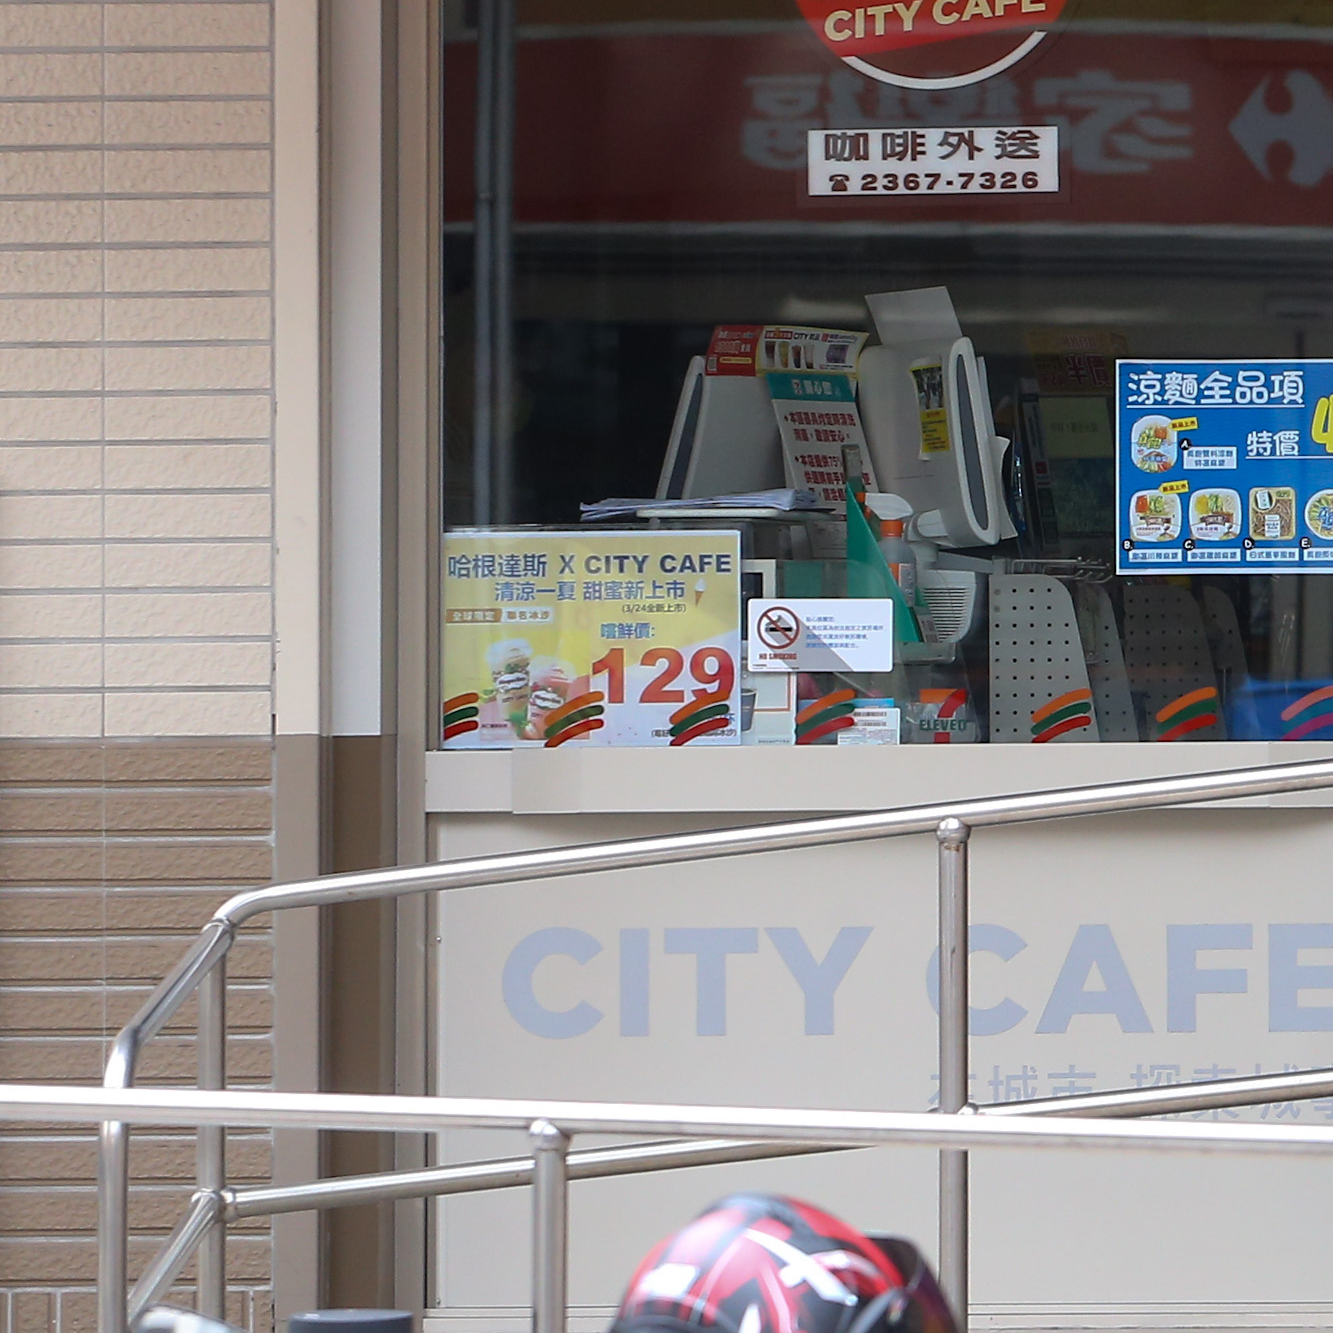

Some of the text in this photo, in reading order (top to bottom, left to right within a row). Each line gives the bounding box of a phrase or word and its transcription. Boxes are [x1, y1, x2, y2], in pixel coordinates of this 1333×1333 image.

[823, 0, 922, 42] CITY
[823, 129, 1042, 163] 咖啡外送
[860, 171, 1039, 192] 2367-7326
[1126, 370, 1305, 406] 涼麵全品項
[1246, 430, 1301, 457] 特價
[447, 553, 548, 579] 哈根達斯
[584, 554, 650, 575] CITY
[659, 553, 733, 574] CAFE
[493, 579, 687, 602] 清涼一夏 甜蜜新上市
[591, 647, 736, 704] 129
[499, 925, 874, 1040] CITY
